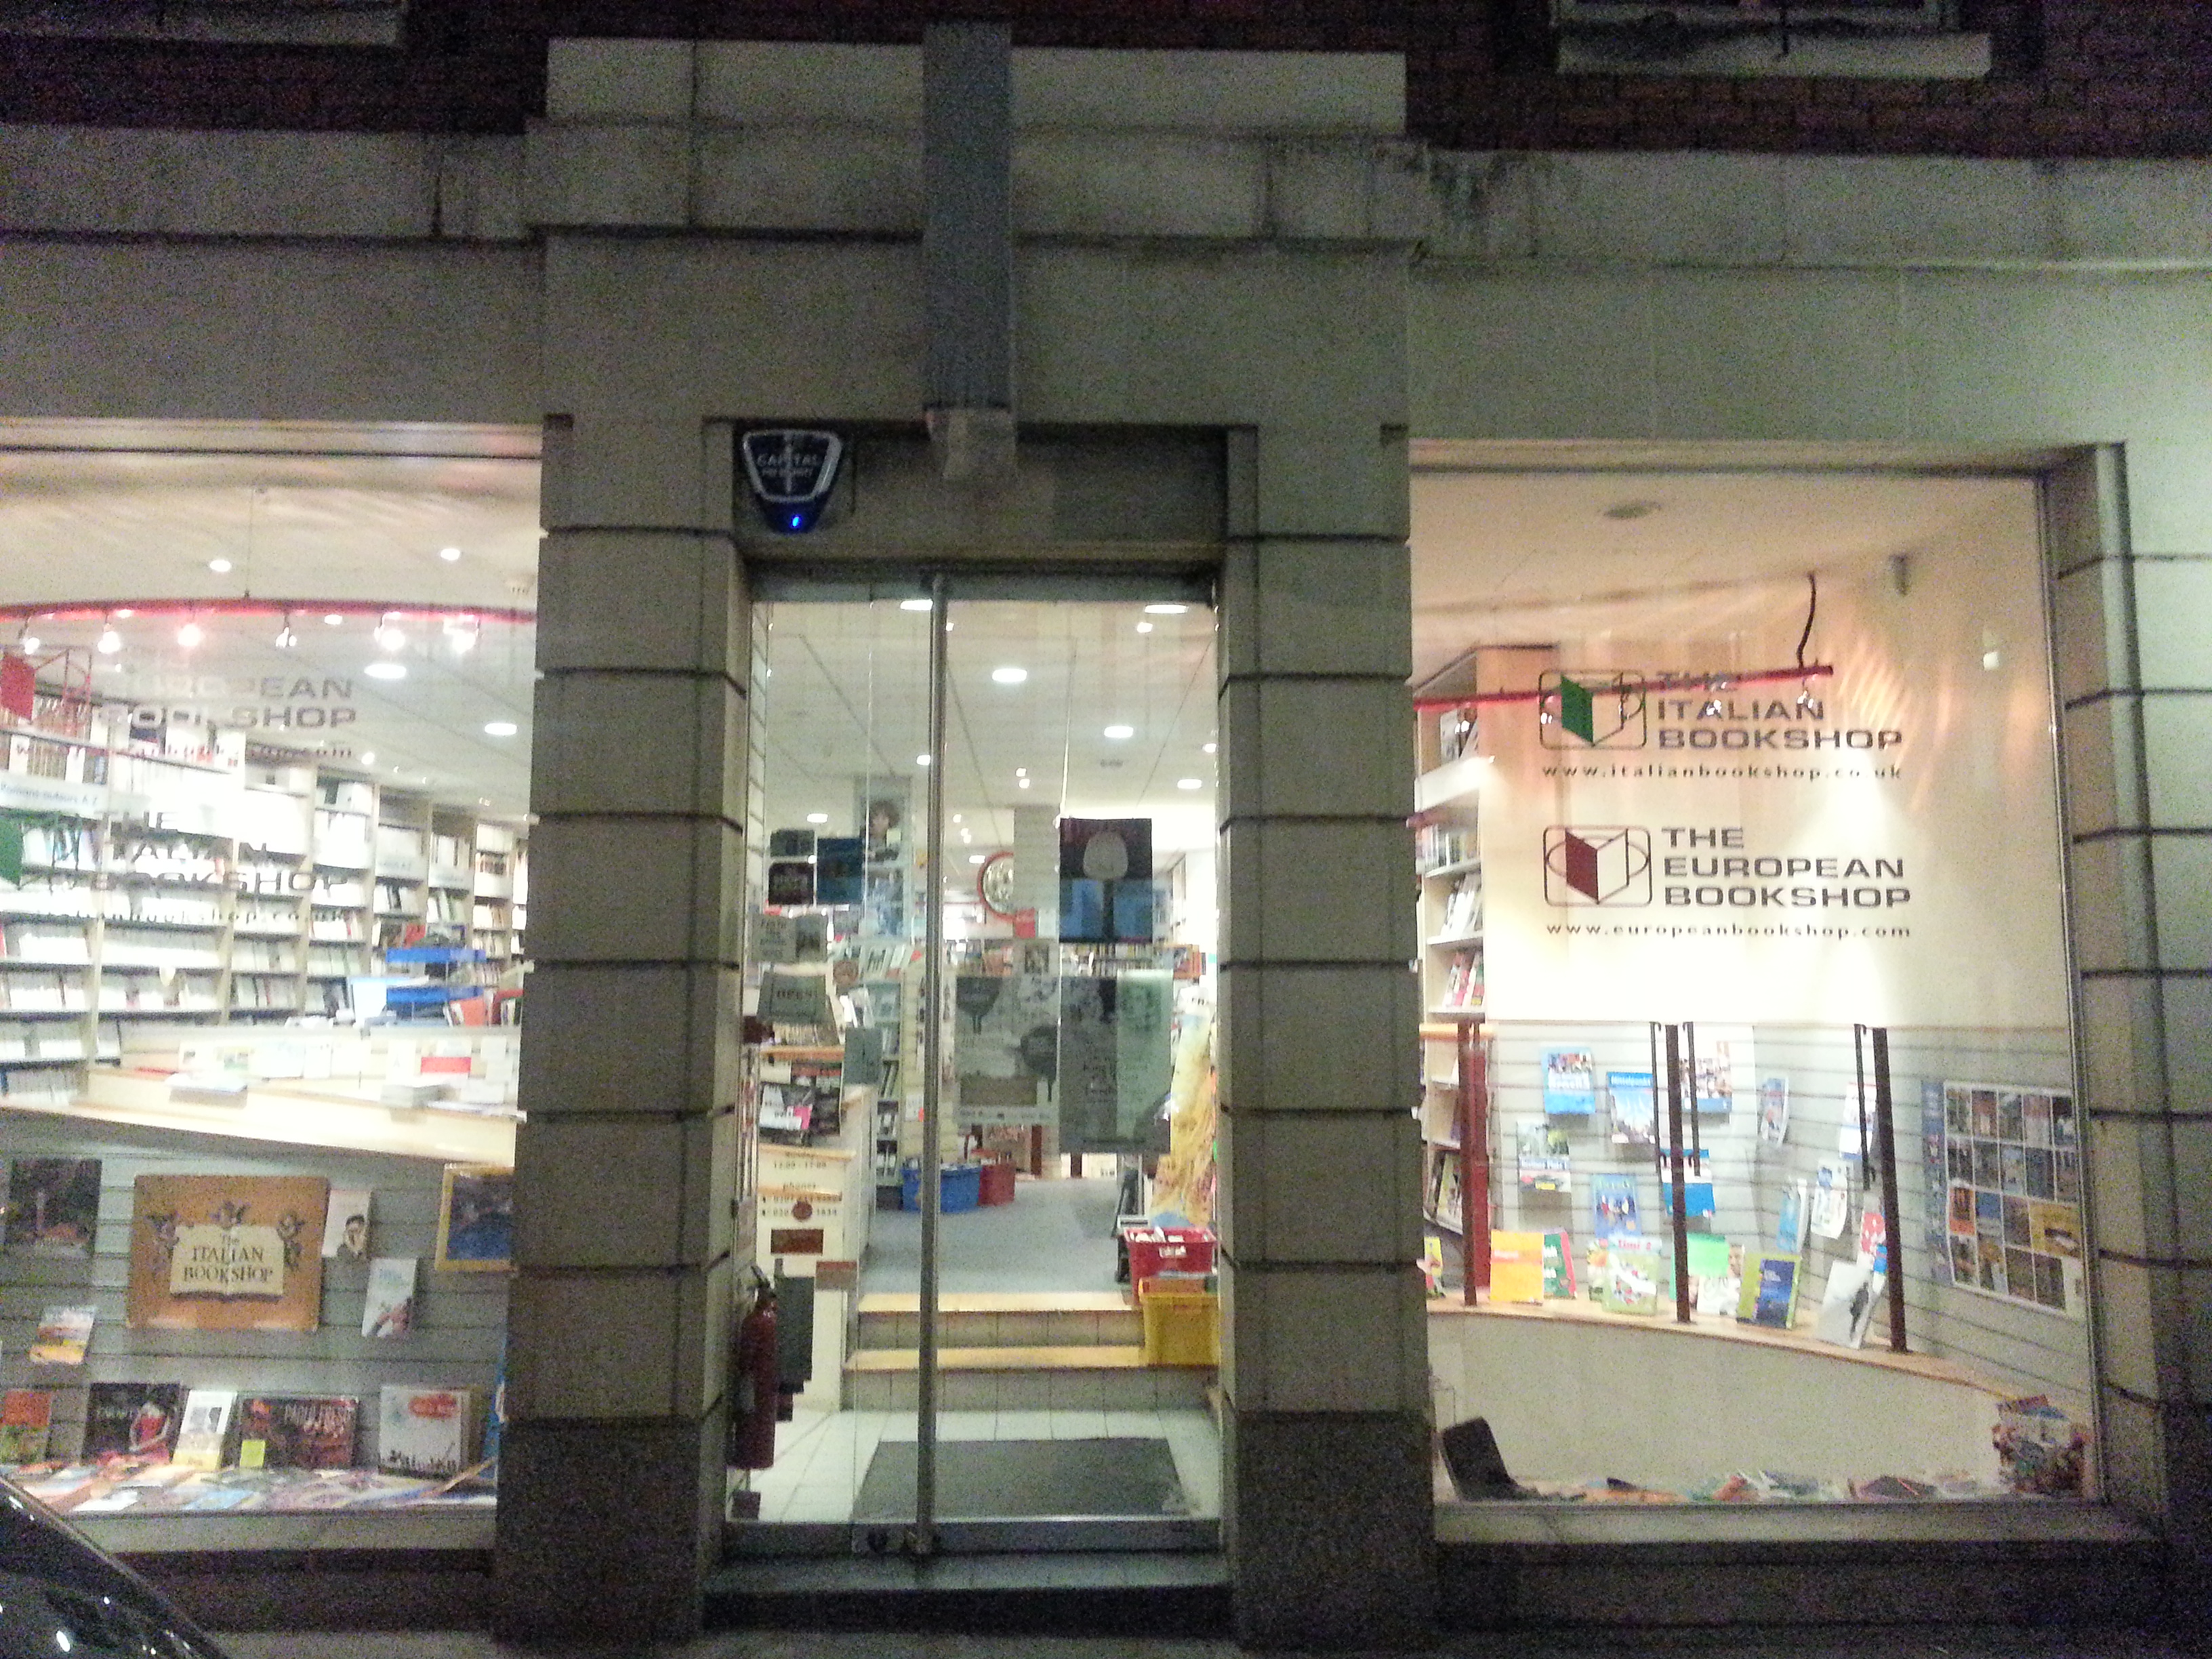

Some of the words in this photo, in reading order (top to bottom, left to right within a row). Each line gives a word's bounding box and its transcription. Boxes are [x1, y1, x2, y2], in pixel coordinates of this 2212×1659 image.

[1658, 699, 1824, 721] ITALIAN
[1658, 729, 1902, 750] BOOKSHOP
[1542, 764, 1902, 783] www.italianbookshop.co.uk
[1662, 827, 1744, 848] THE
[1664, 857, 1905, 879] EUROPEAN
[1664, 886, 1912, 908] BOOKSHOP
[1547, 922, 1912, 941] www.europeanbookshop.com
[192, 1246, 264, 1264] ITALIAN
[184, 1265, 273, 1285] BOOKSHOP
